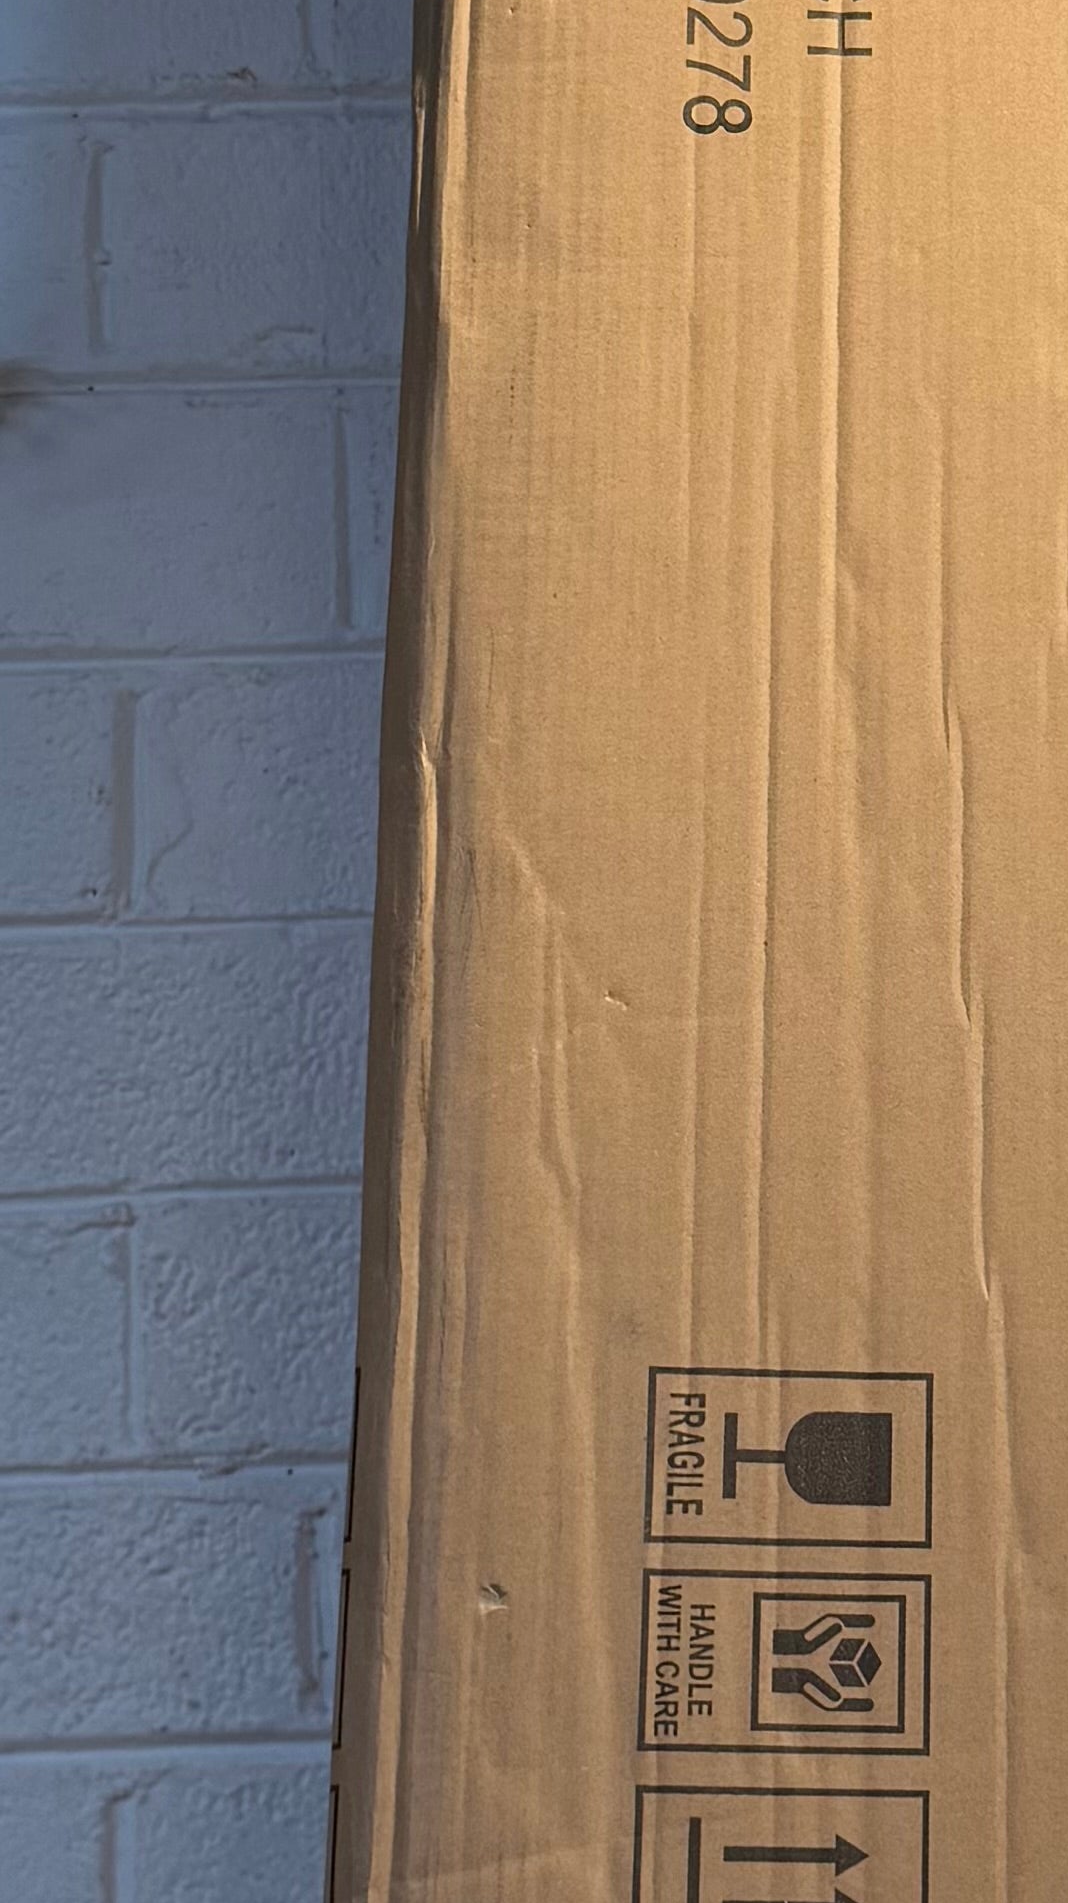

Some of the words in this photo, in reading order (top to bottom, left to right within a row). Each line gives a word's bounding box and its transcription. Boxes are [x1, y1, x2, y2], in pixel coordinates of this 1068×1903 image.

[666, 1392, 707, 1517] FRAGILE
[659, 1584, 685, 1653] WITH
[685, 1603, 715, 1718] HANDLE
[652, 1661, 680, 1737] CARE
